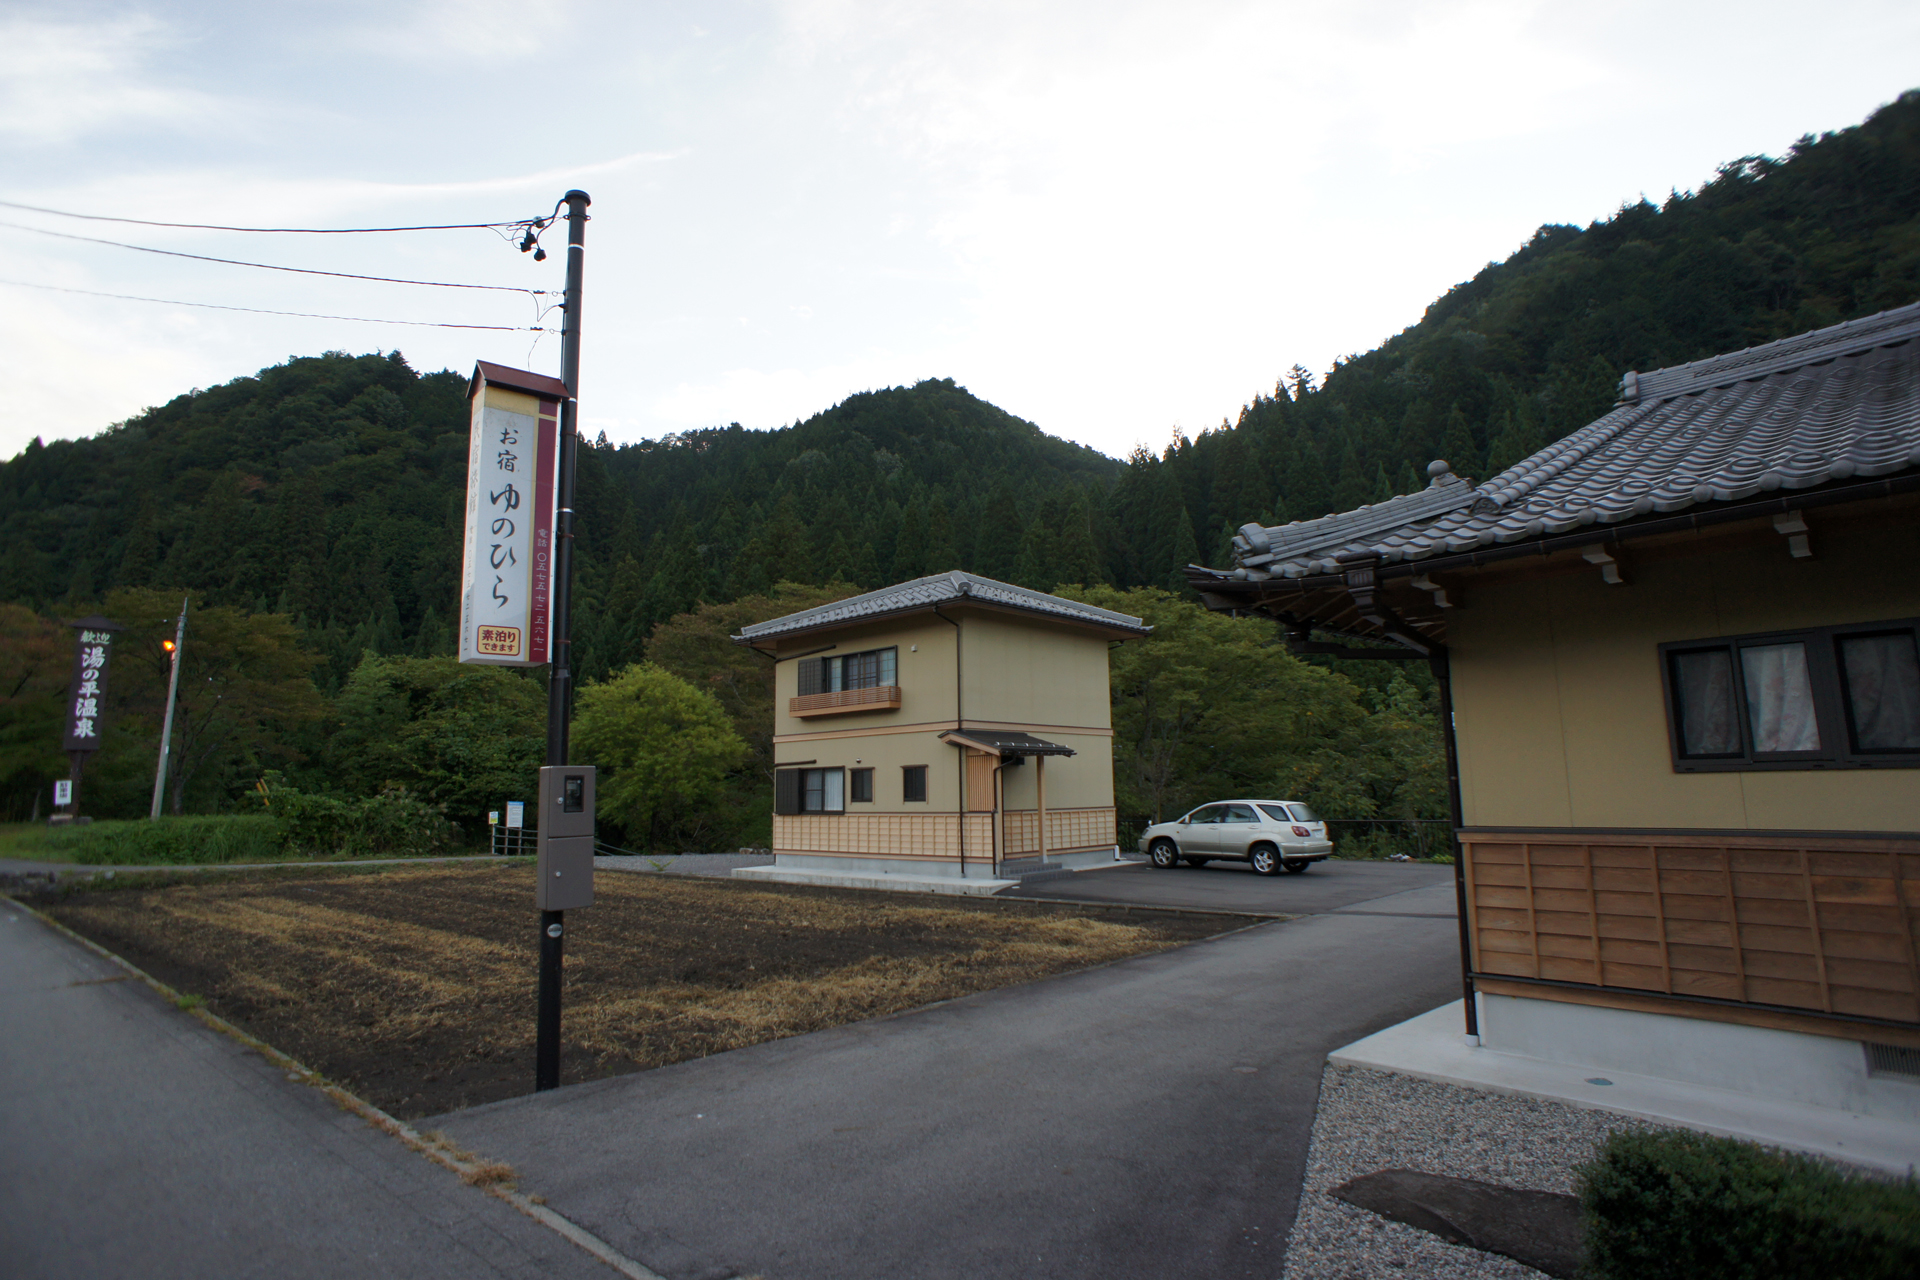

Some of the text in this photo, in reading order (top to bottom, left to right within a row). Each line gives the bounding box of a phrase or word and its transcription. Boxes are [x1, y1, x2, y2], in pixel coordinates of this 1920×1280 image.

[489, 427, 520, 609] お宿 ゆのひら
[537, 528, 549, 547] 電話
[80, 630, 111, 645] 歓迎
[481, 629, 517, 643] 素泊り
[481, 642, 516, 653] できます
[73, 646, 106, 739] 湯の平温泉
